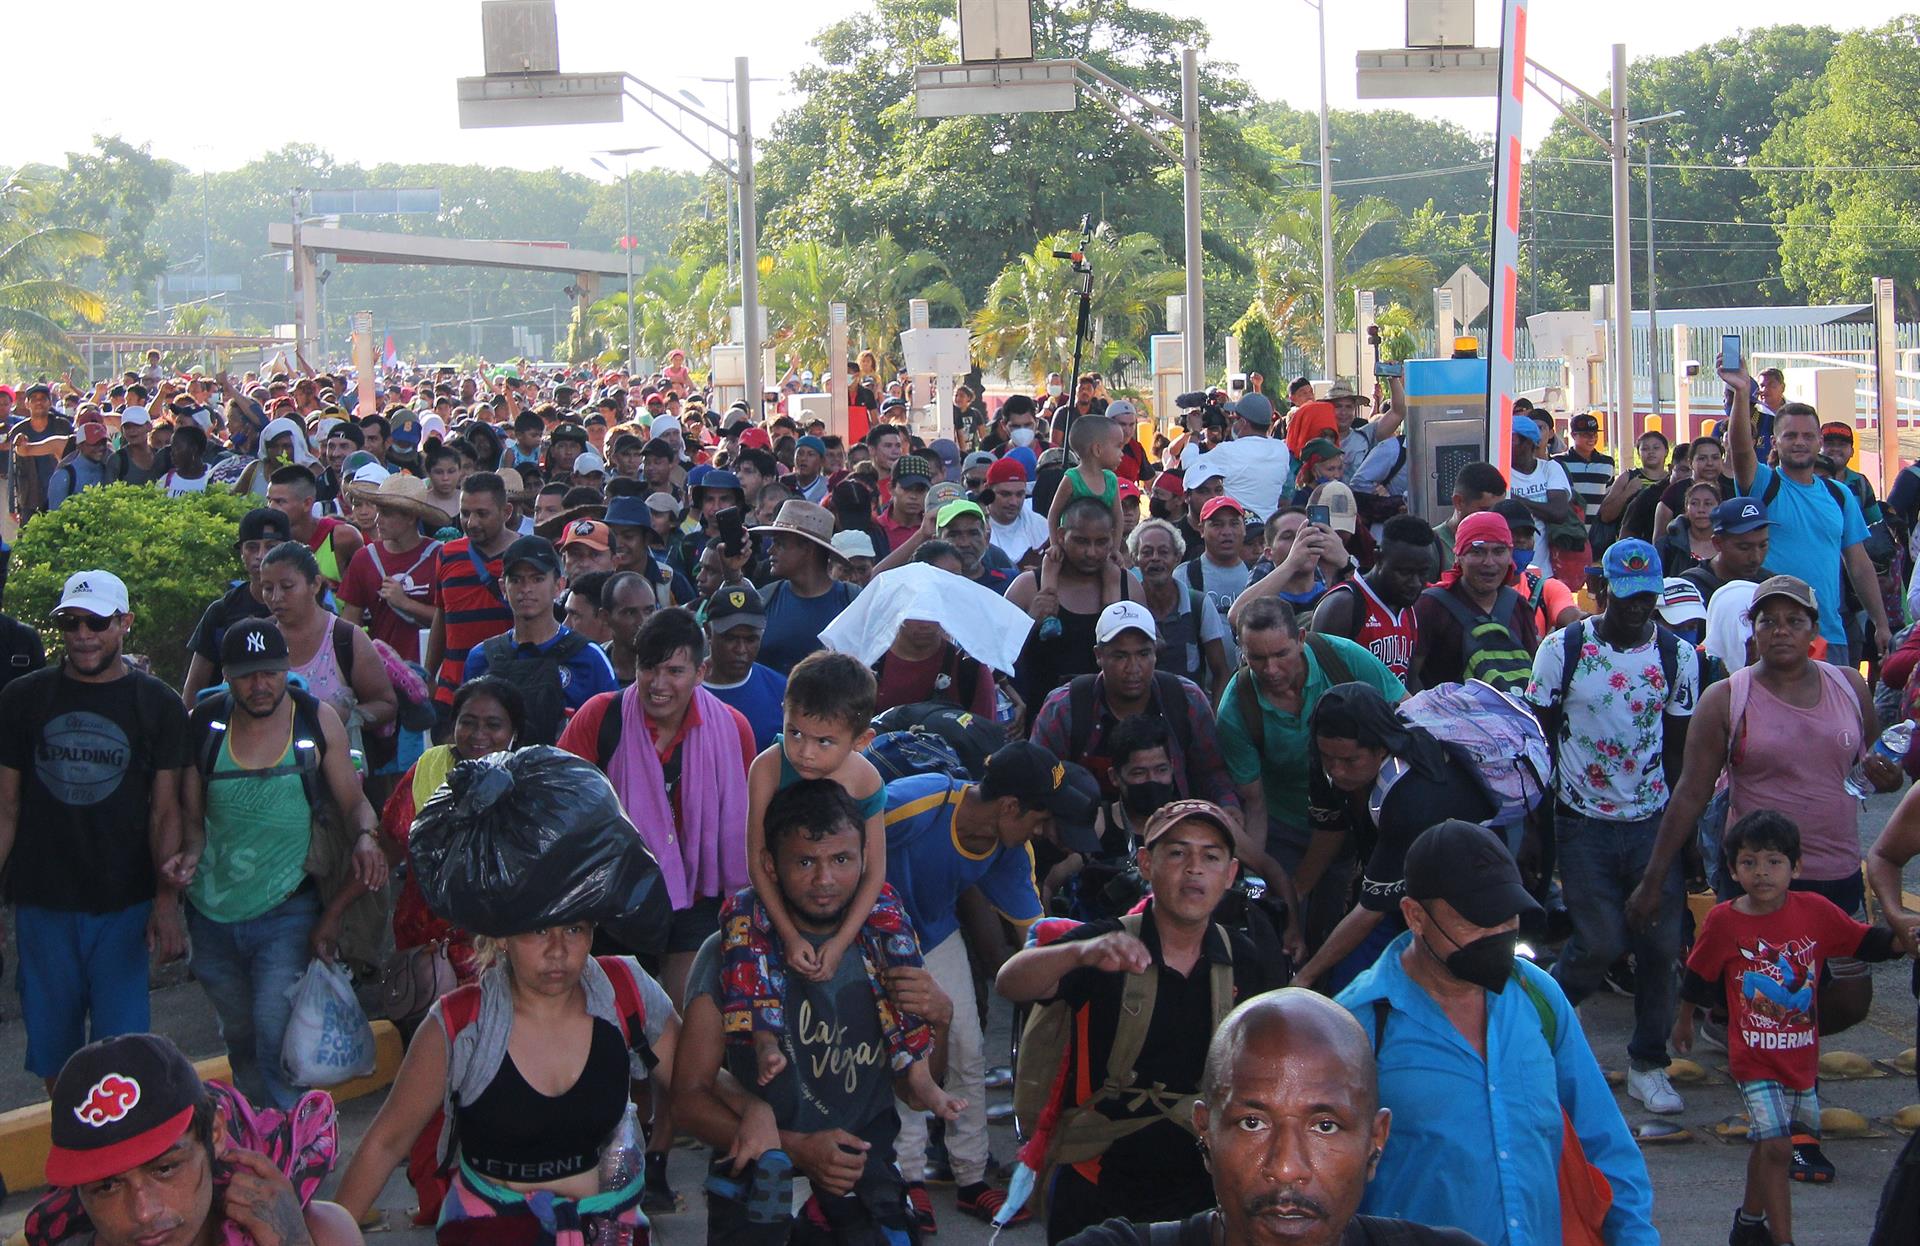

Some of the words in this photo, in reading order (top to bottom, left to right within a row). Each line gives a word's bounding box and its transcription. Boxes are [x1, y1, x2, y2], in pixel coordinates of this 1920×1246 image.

[247, 631, 266, 652] NY
[799, 1000, 848, 1046] las
[320, 1033, 353, 1054] POR
